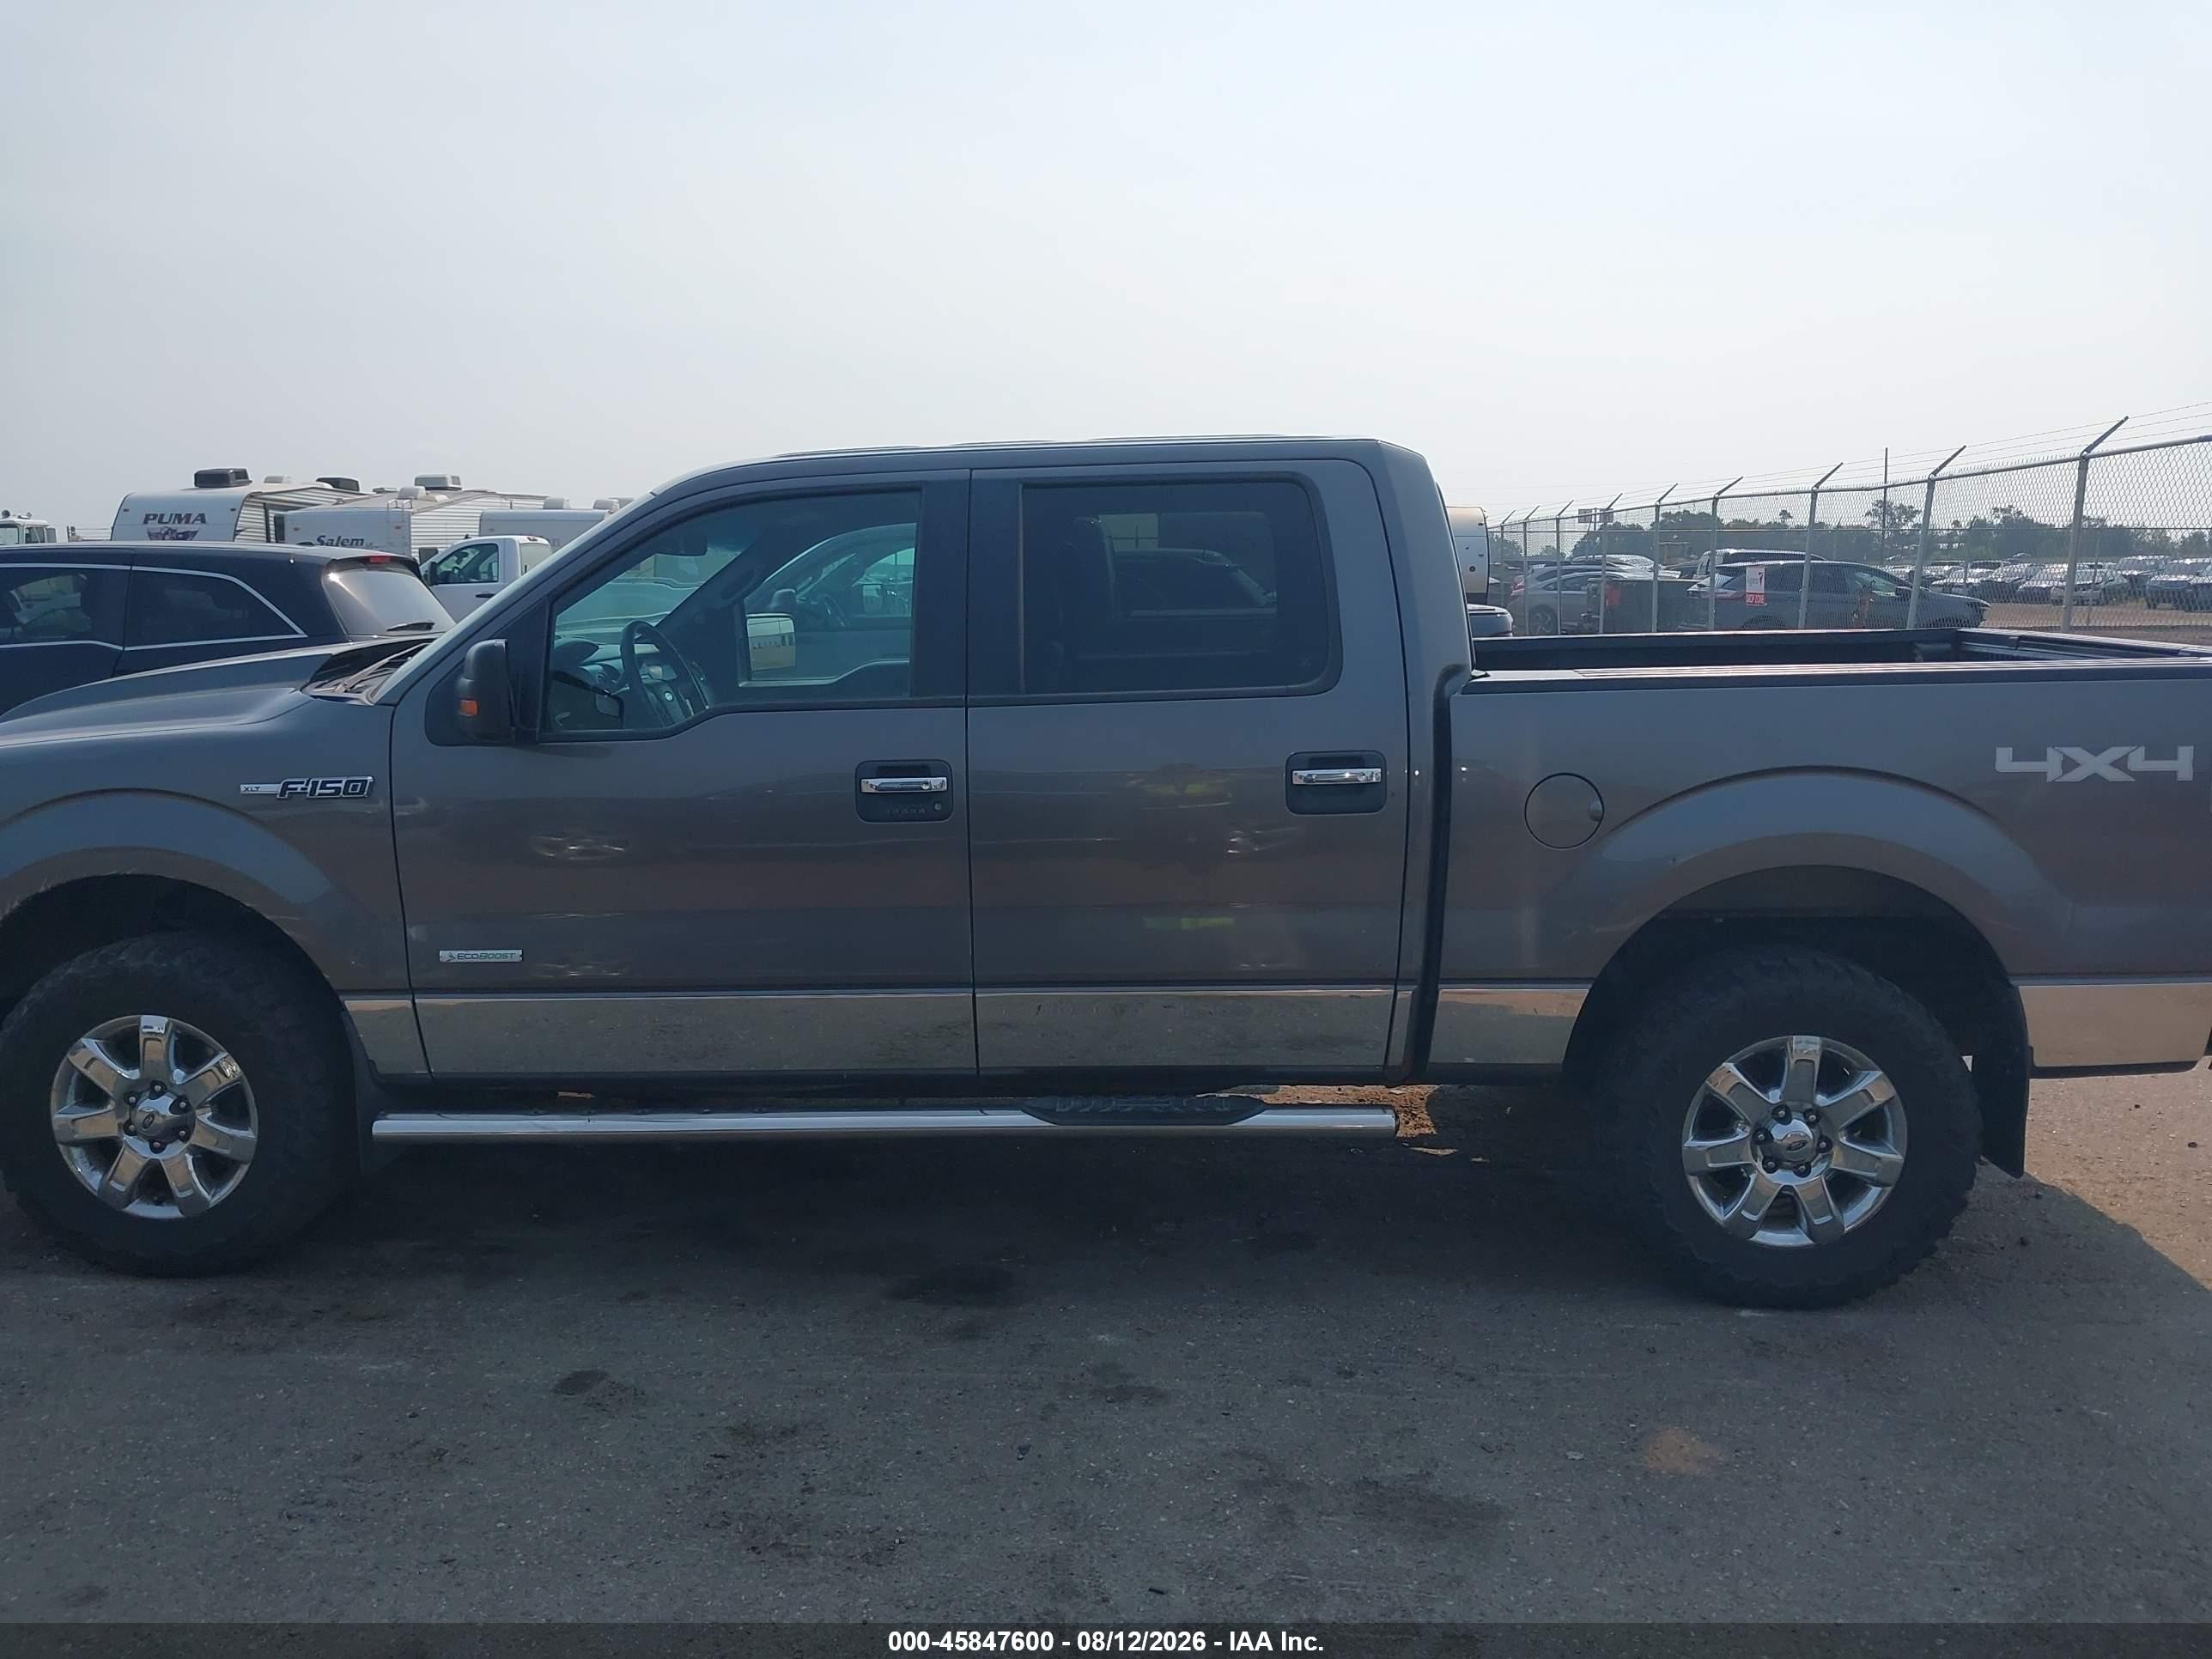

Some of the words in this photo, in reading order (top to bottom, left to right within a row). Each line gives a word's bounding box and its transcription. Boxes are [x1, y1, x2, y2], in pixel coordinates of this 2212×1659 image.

[143, 513, 207, 526] PUMA
[316, 535, 365, 547] Salem
[276, 776, 373, 799] F-150
